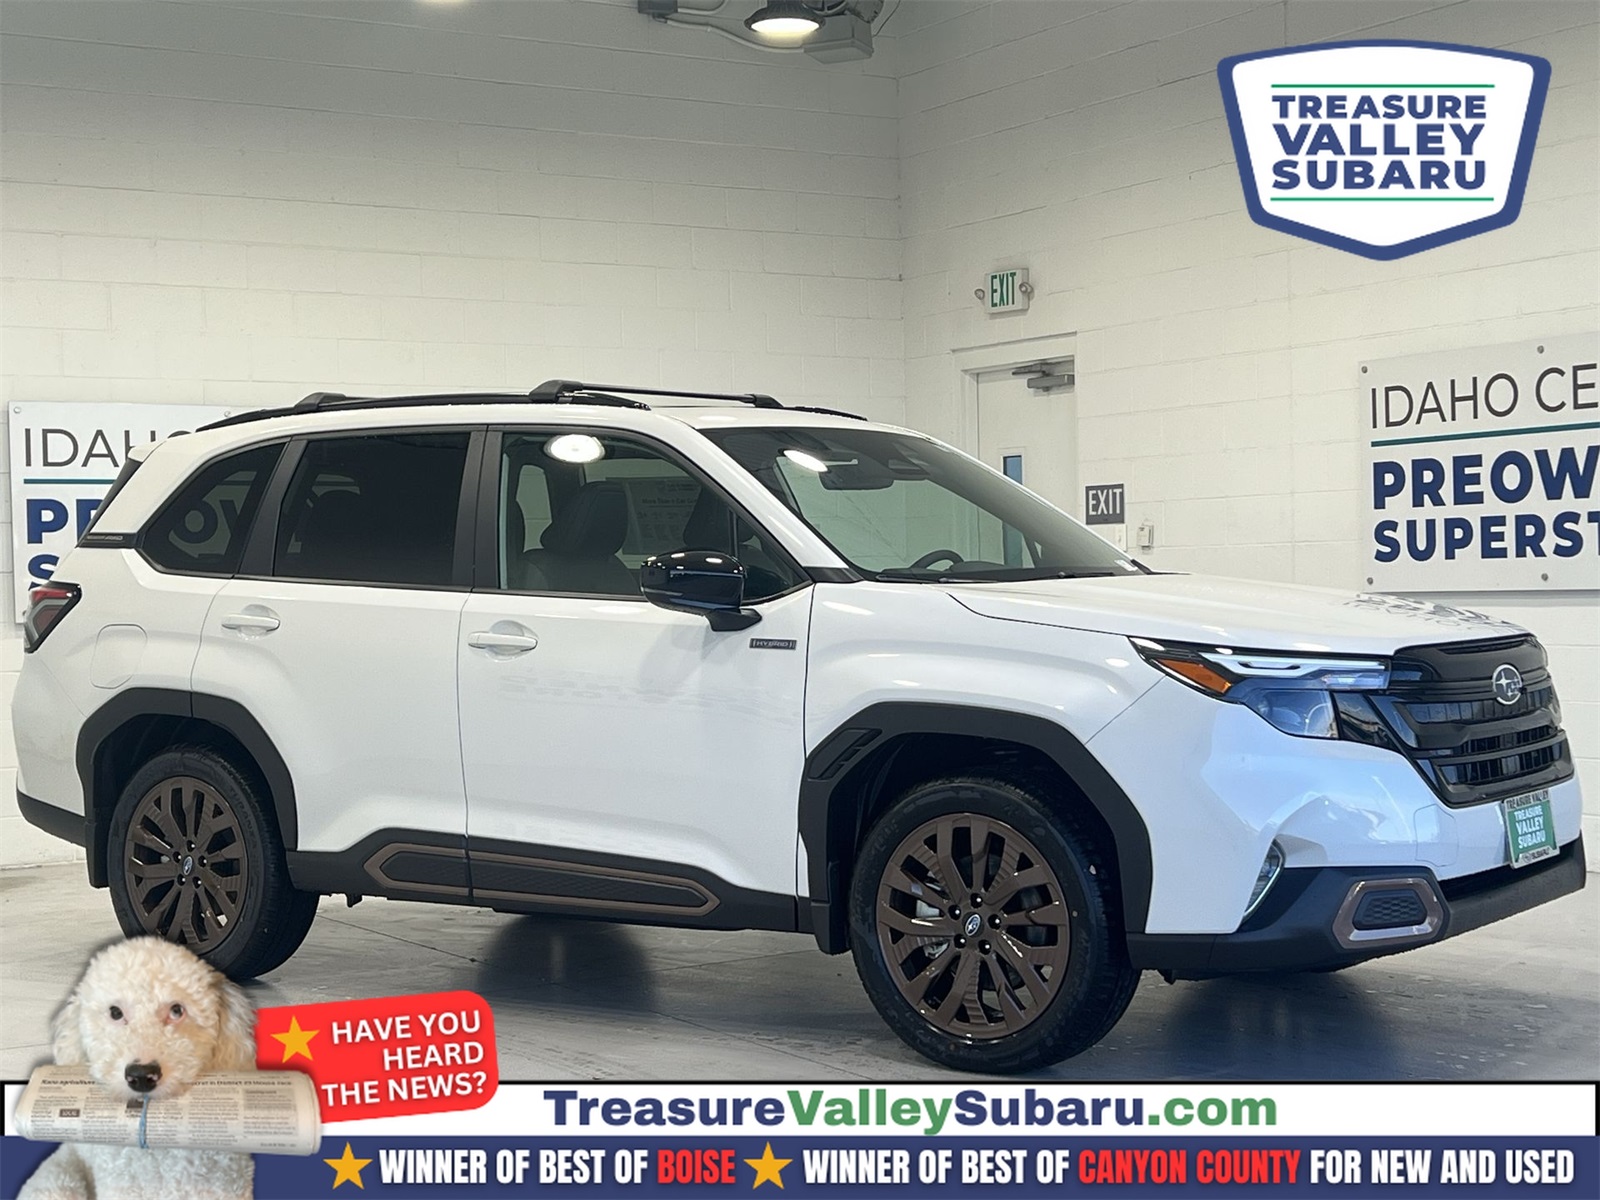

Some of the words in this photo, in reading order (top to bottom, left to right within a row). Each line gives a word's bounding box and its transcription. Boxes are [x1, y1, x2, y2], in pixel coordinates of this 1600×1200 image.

[990, 271, 1017, 307] EXIT
[1371, 373, 1519, 429] IDAHO
[1535, 363, 1600, 412] CE
[1373, 445, 1600, 509] PREOW
[1088, 488, 1123, 515] EXIT
[1514, 805, 1543, 820] TREASURE
[1516, 816, 1544, 835] VALLEY
[1518, 830, 1546, 849] SUBARU
